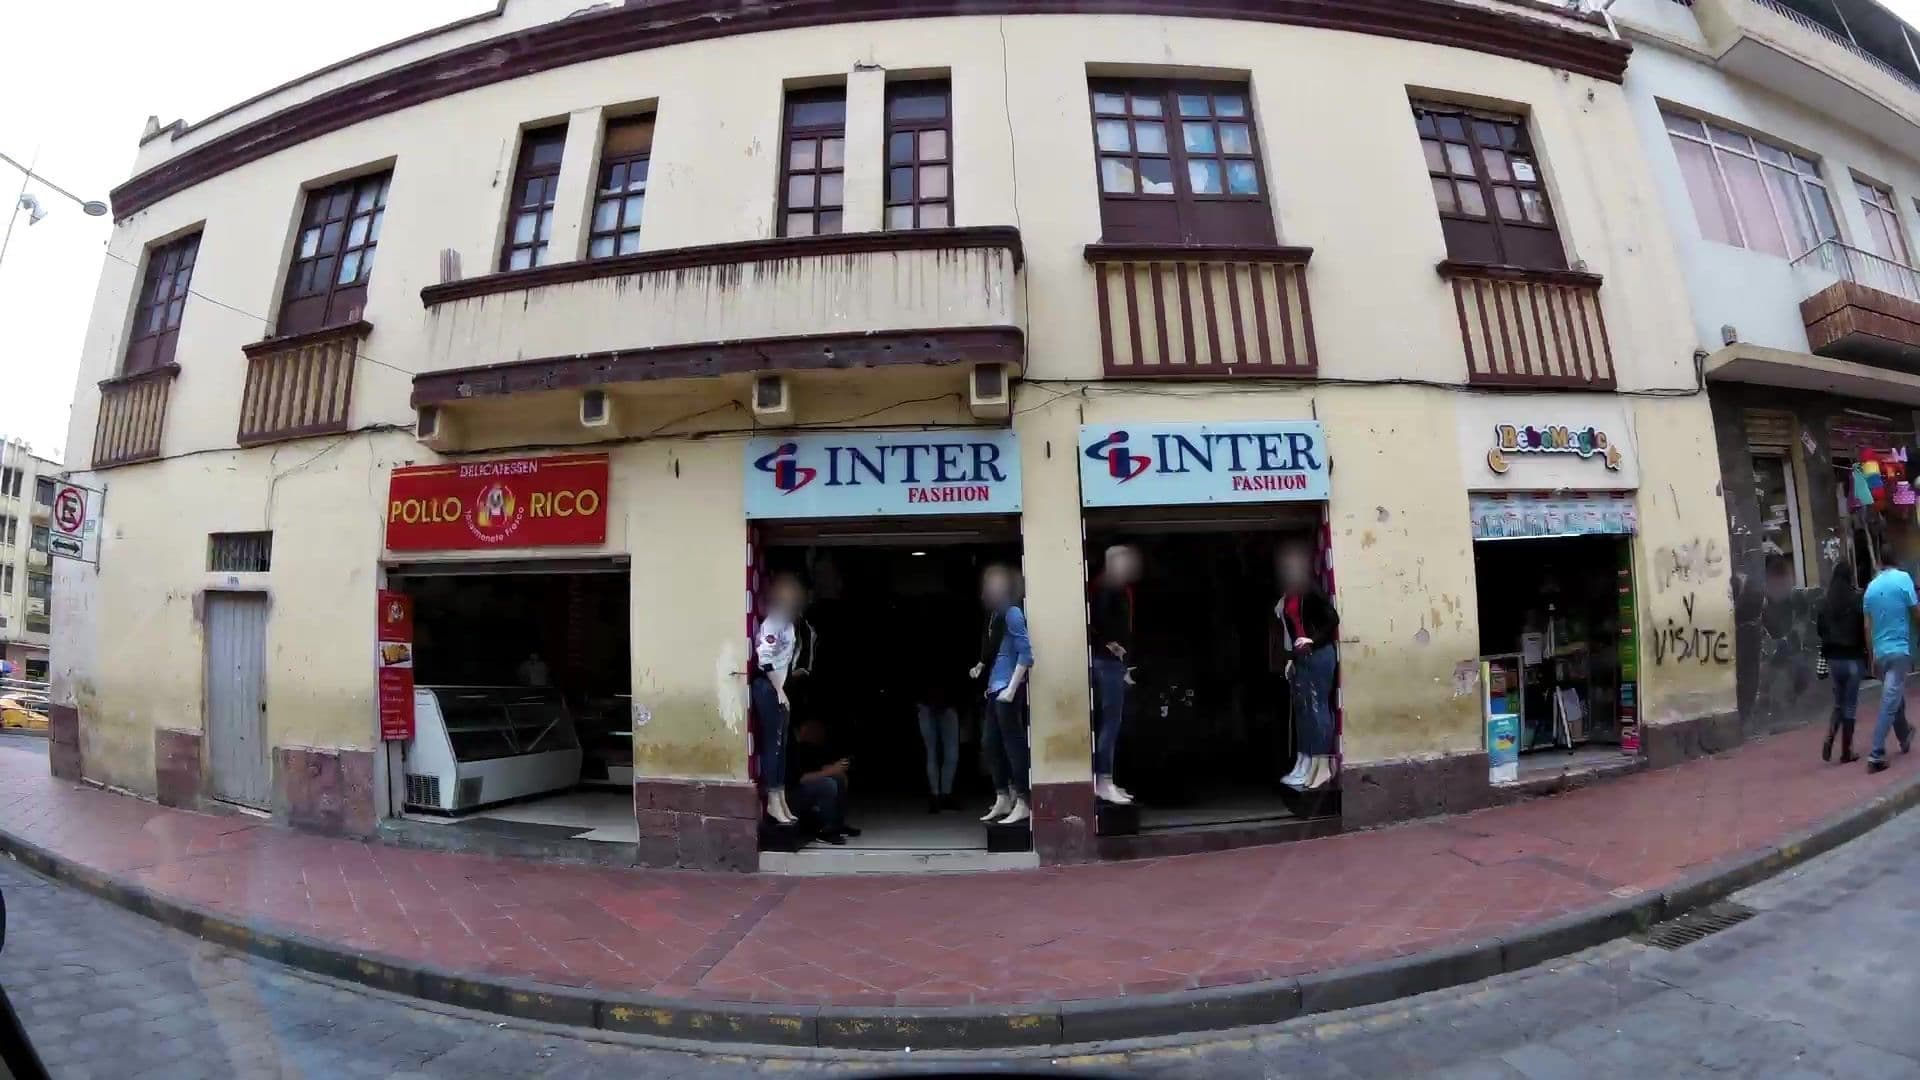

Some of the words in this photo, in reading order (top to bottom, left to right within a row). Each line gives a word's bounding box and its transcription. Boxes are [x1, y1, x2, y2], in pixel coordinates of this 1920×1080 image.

[824, 443, 1007, 486] INTER
[1152, 432, 1321, 473] INTER
[459, 460, 538, 477] DELICATESSEN
[908, 485, 989, 503] FASHION
[1232, 474, 1306, 491] FASHION
[389, 497, 462, 524] POLLO
[530, 489, 600, 518] RICO
